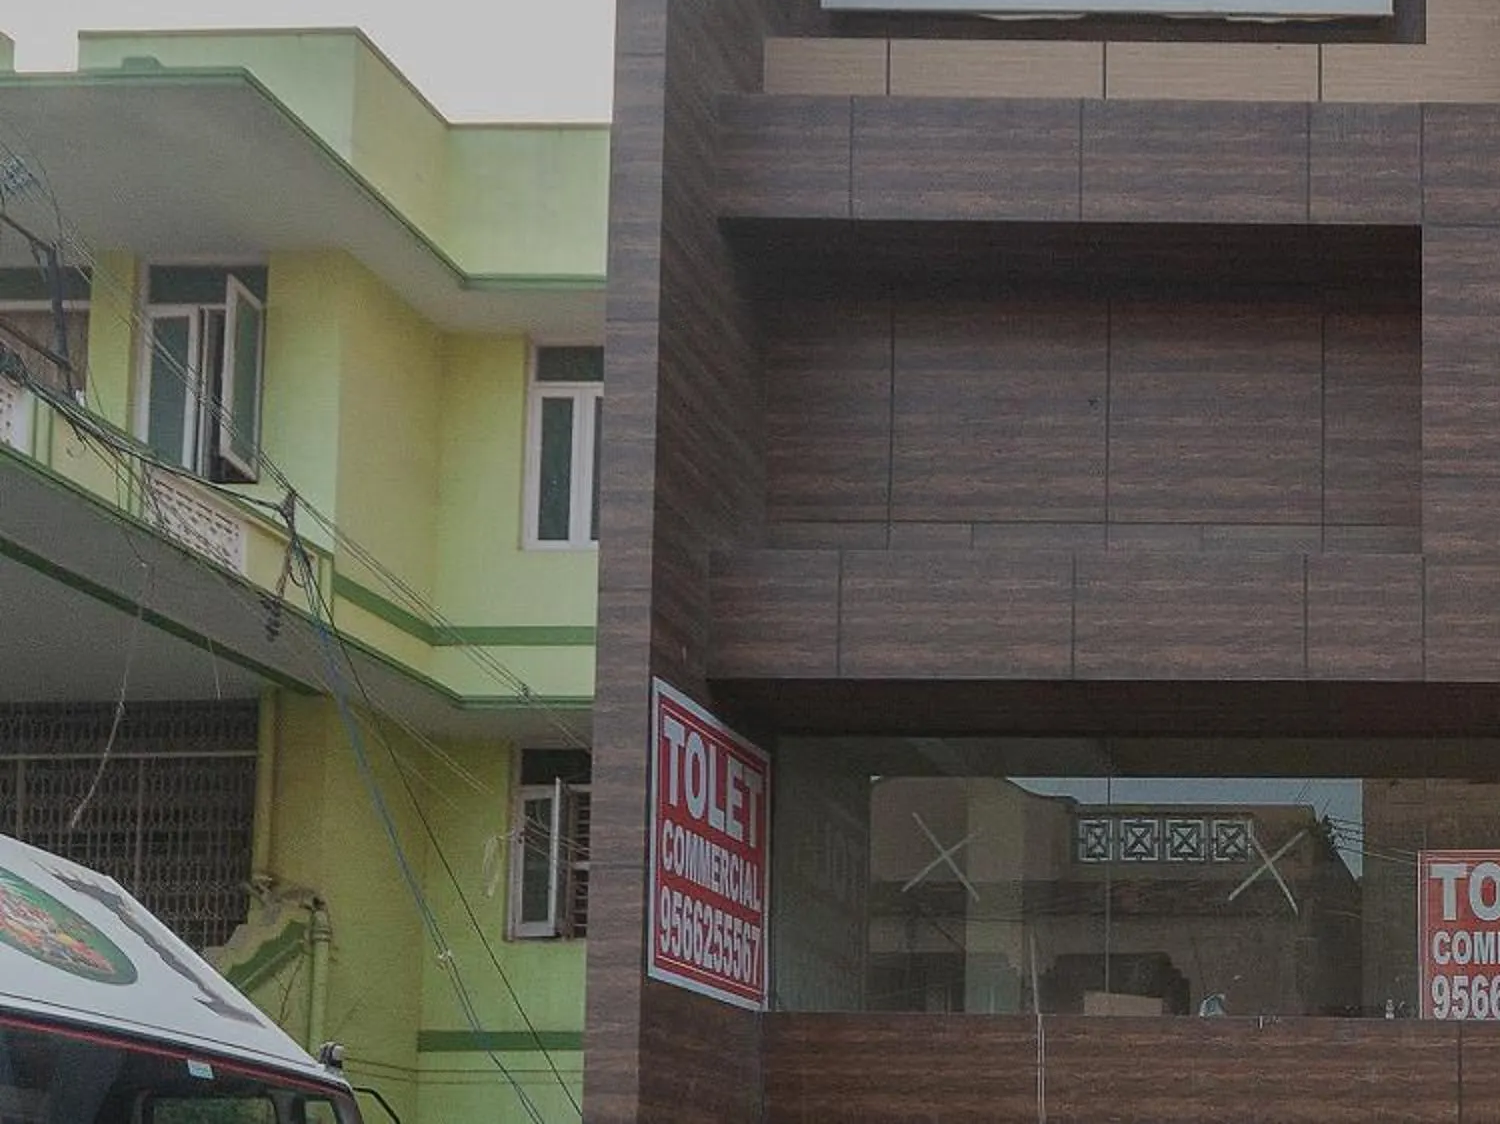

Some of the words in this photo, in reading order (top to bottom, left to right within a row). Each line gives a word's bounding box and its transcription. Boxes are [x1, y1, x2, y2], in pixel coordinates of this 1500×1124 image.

[663, 715, 764, 849] TOLET
[662, 819, 762, 913] COMMERCIAL
[660, 886, 761, 986] 9566255567
